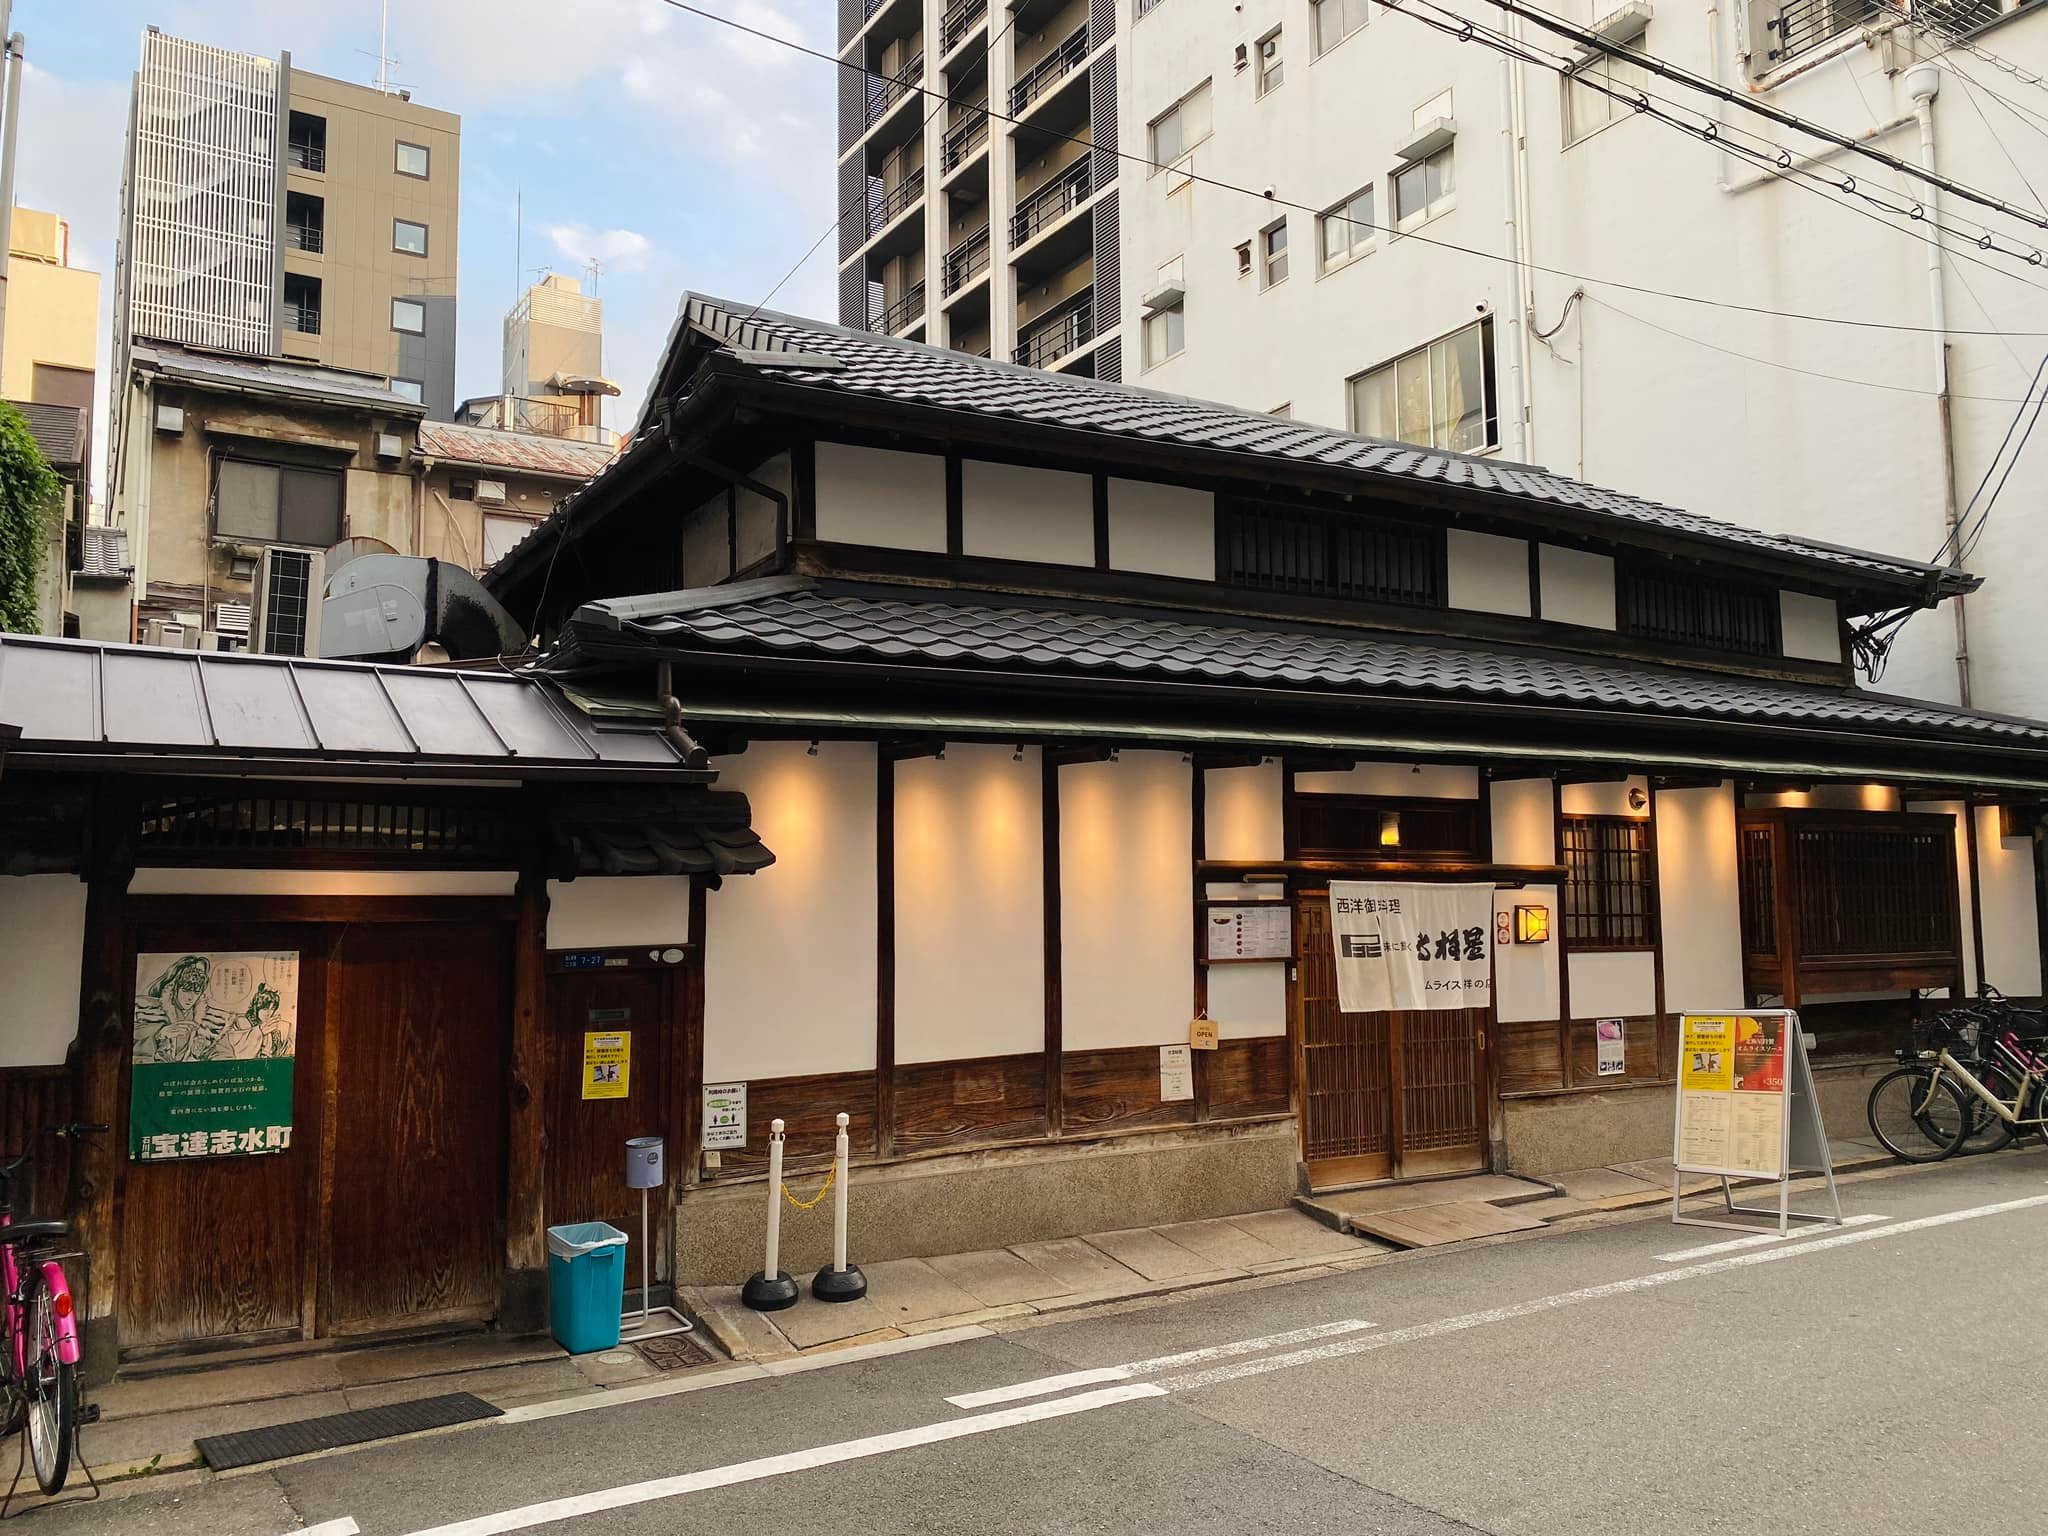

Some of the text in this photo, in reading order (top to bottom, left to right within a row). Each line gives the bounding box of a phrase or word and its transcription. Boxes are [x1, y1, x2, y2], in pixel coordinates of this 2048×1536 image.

[151, 1125, 293, 1159] 宝達志水町
